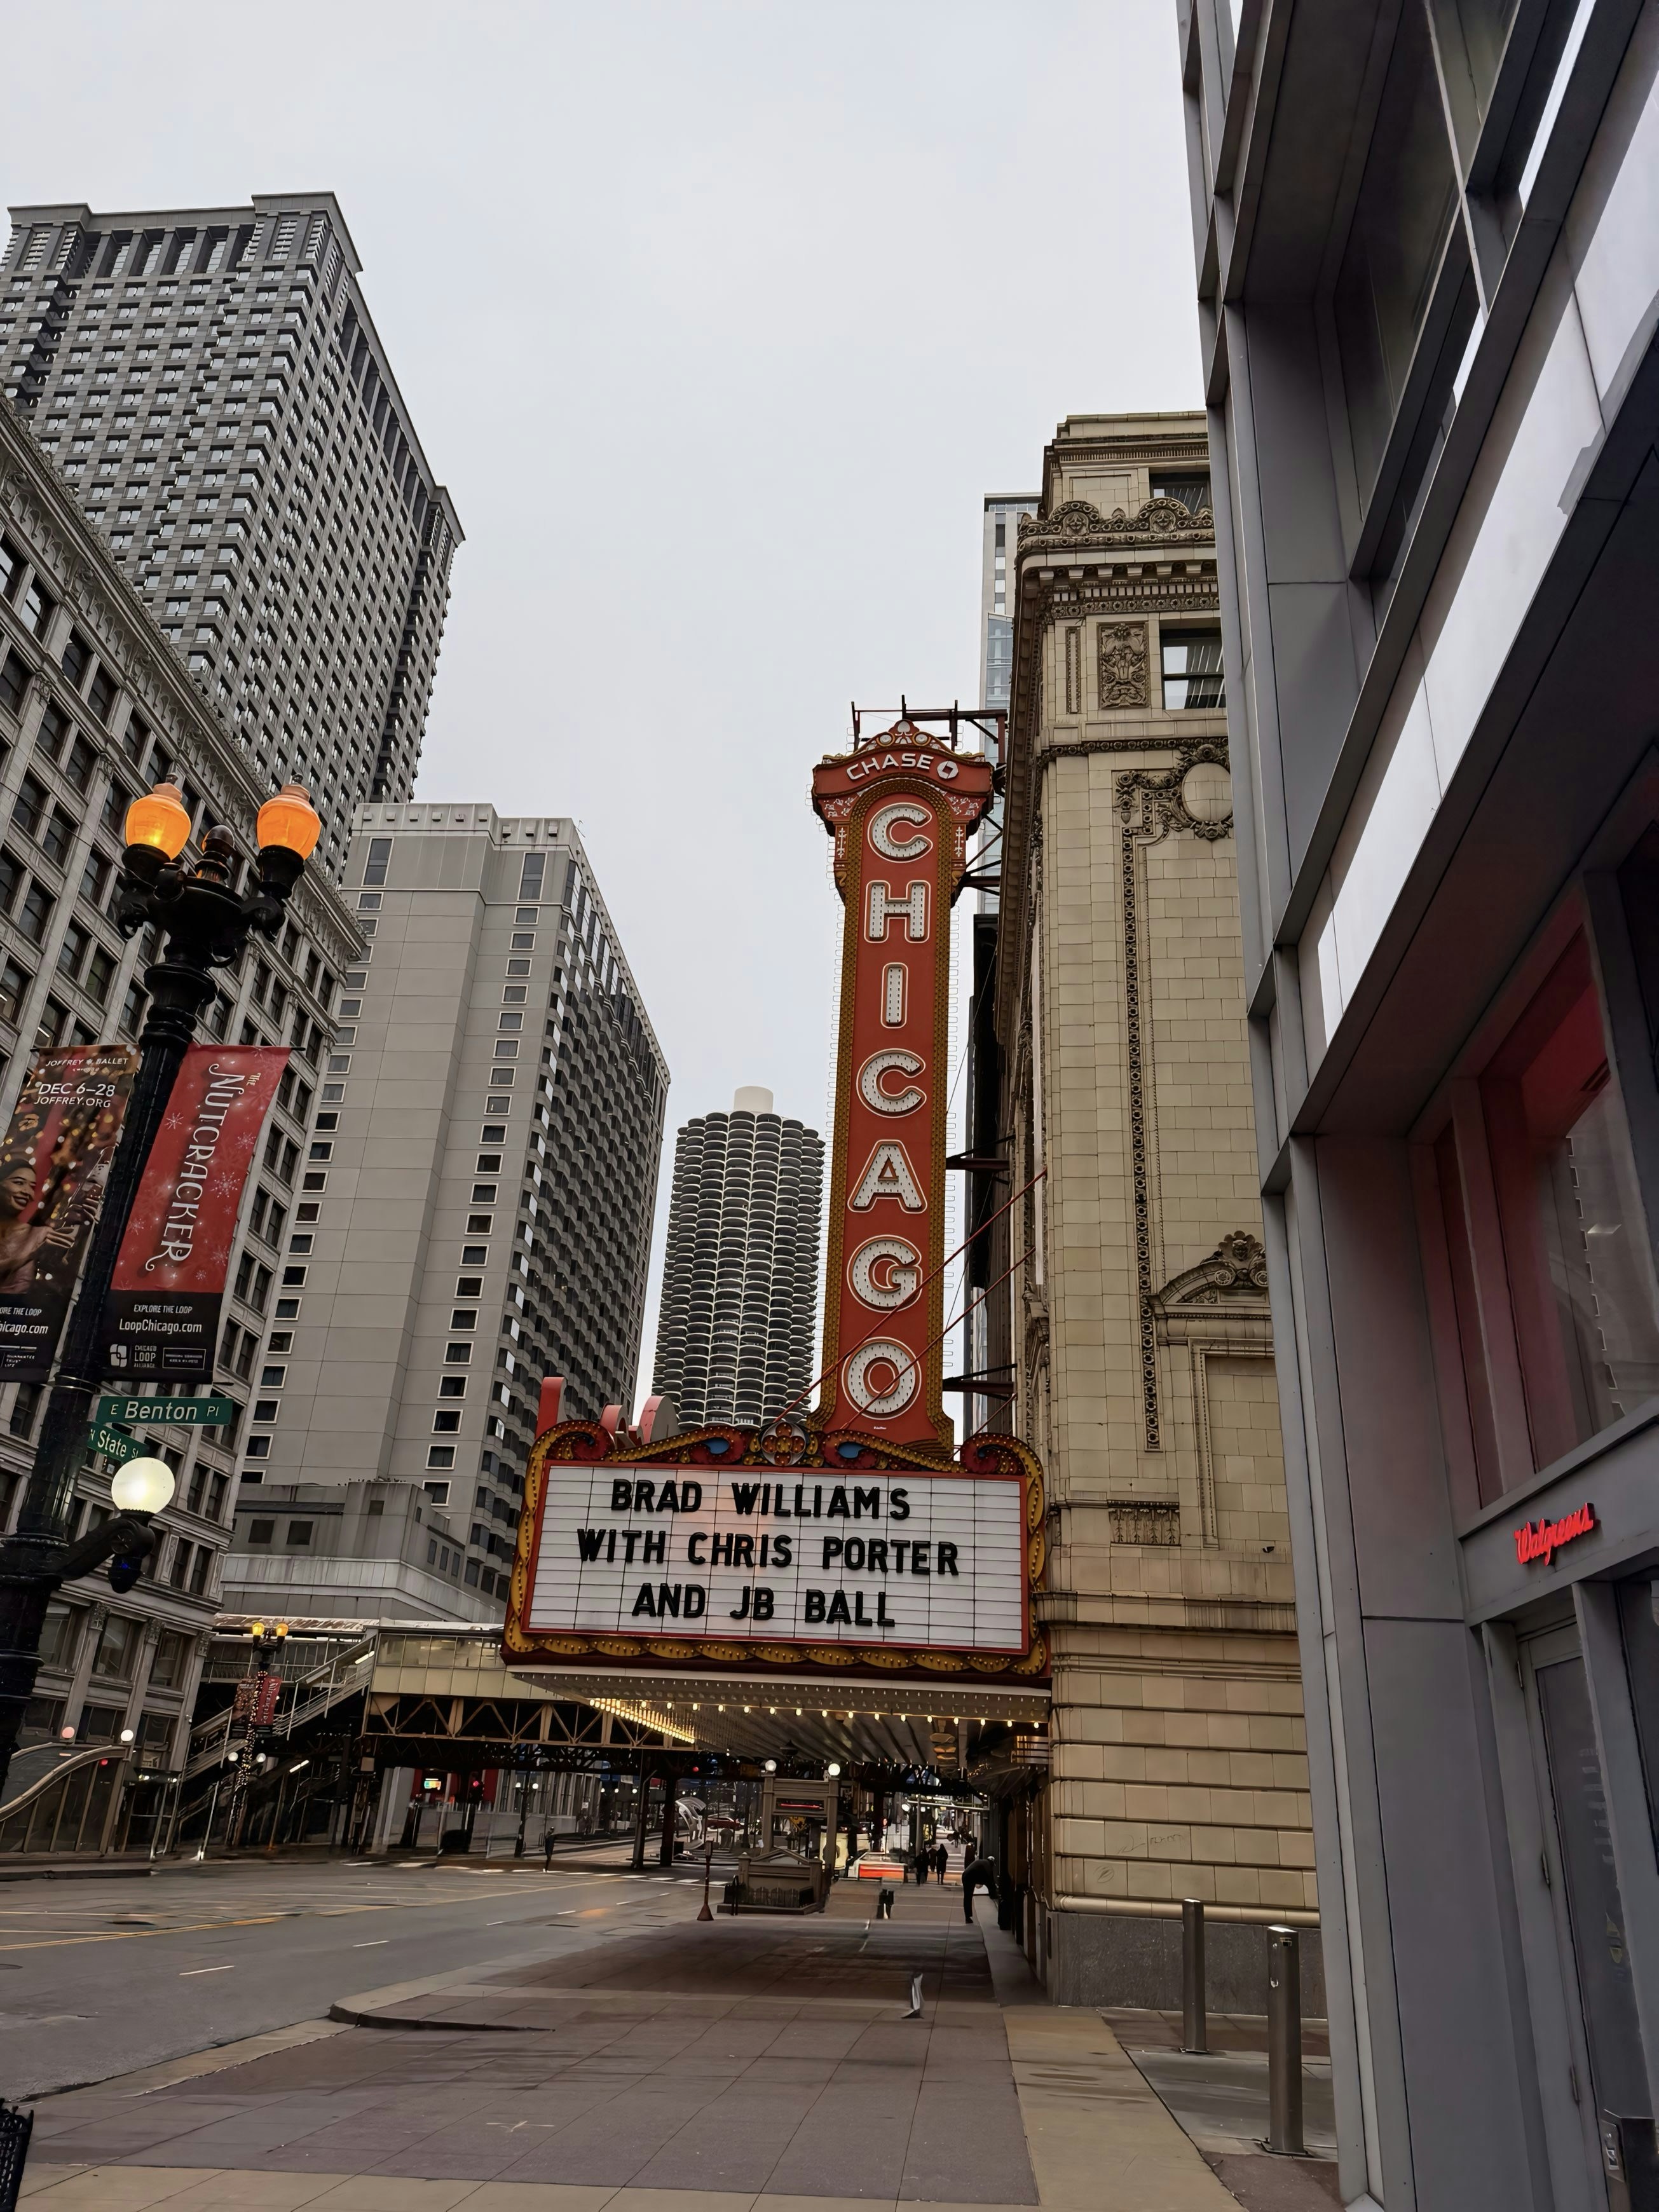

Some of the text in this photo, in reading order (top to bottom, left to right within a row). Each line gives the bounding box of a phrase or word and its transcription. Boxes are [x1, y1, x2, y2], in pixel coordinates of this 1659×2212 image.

[847, 753, 934, 781] CHASE
[38, 1083, 73, 1095] DEC
[245, 1072, 261, 1086] THE
[34, 1096, 112, 1109] JOFFREY.ORG
[843, 802, 933, 1421] CHICAGO
[145, 1063, 245, 1271] NUTCRACKER
[25, 1308, 42, 1316] LOOP
[119, 1318, 202, 1335] LoopChicago.com
[134, 1352, 156, 1362] LOOP
[111, 1401, 219, 1421] E Benton Pl
[97, 1430, 127, 1458] State
[610, 1478, 911, 1520] BRAD WILLIAMS
[1514, 1503, 1594, 1566] Walgreens
[577, 1527, 959, 1576] WITH CHRIS PORTER
[632, 1582, 896, 1627] AND JB BALL
